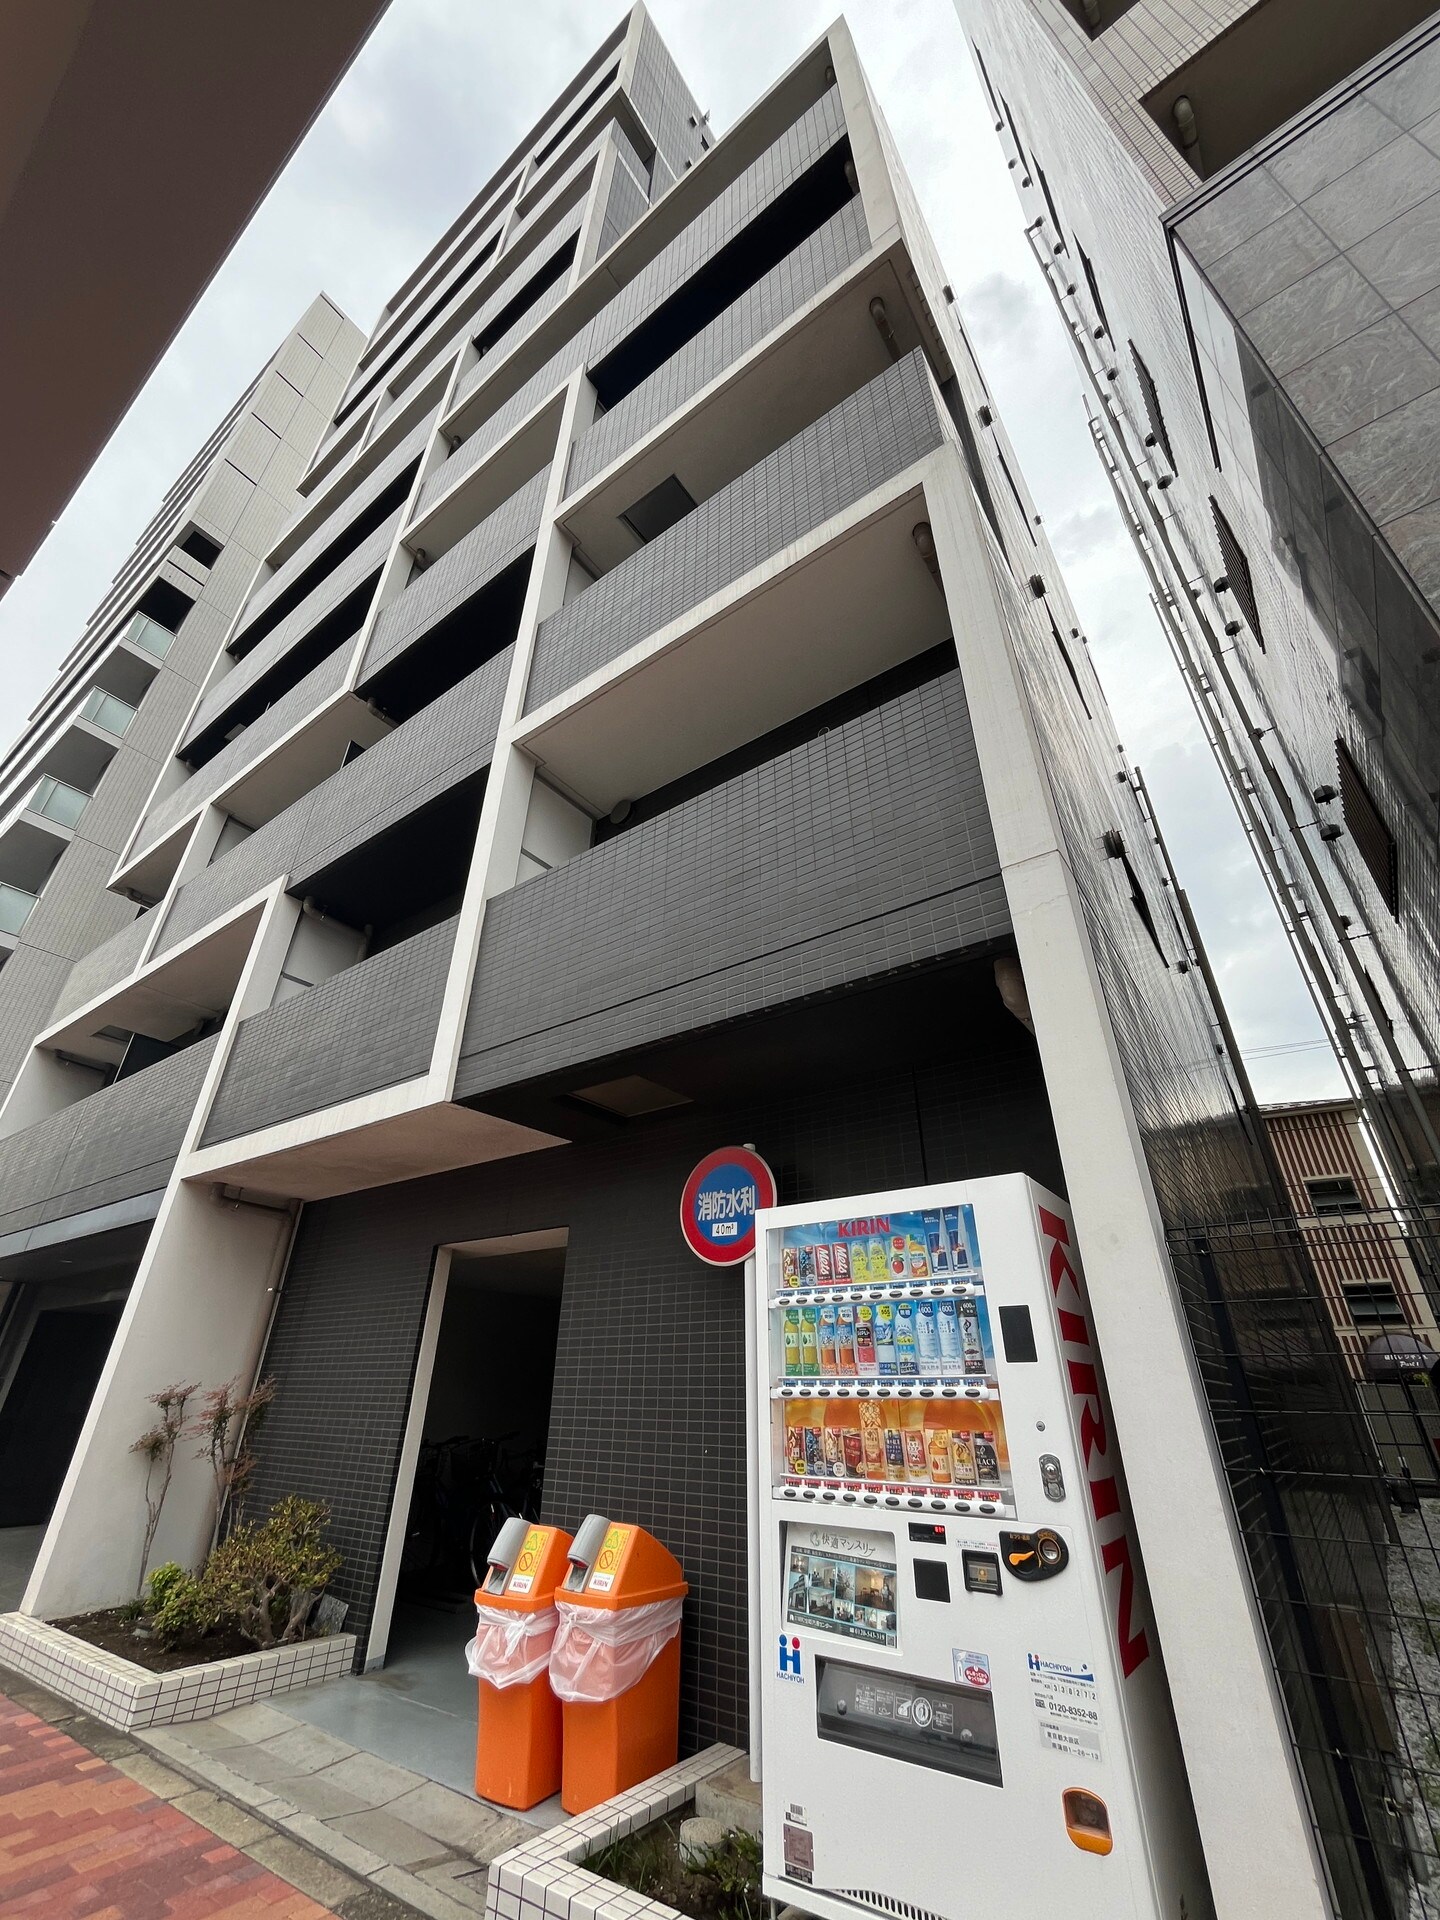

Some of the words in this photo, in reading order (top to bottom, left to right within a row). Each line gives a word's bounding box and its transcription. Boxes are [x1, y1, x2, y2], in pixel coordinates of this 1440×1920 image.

[698, 1185, 756, 1221] 消防水利
[838, 1217, 890, 1238] KIRIN
[1038, 1204, 1150, 1680] KIRIN
[1040, 1660, 1072, 1673] HACHIYOH
[776, 1671, 805, 1684] HACHIYOH
